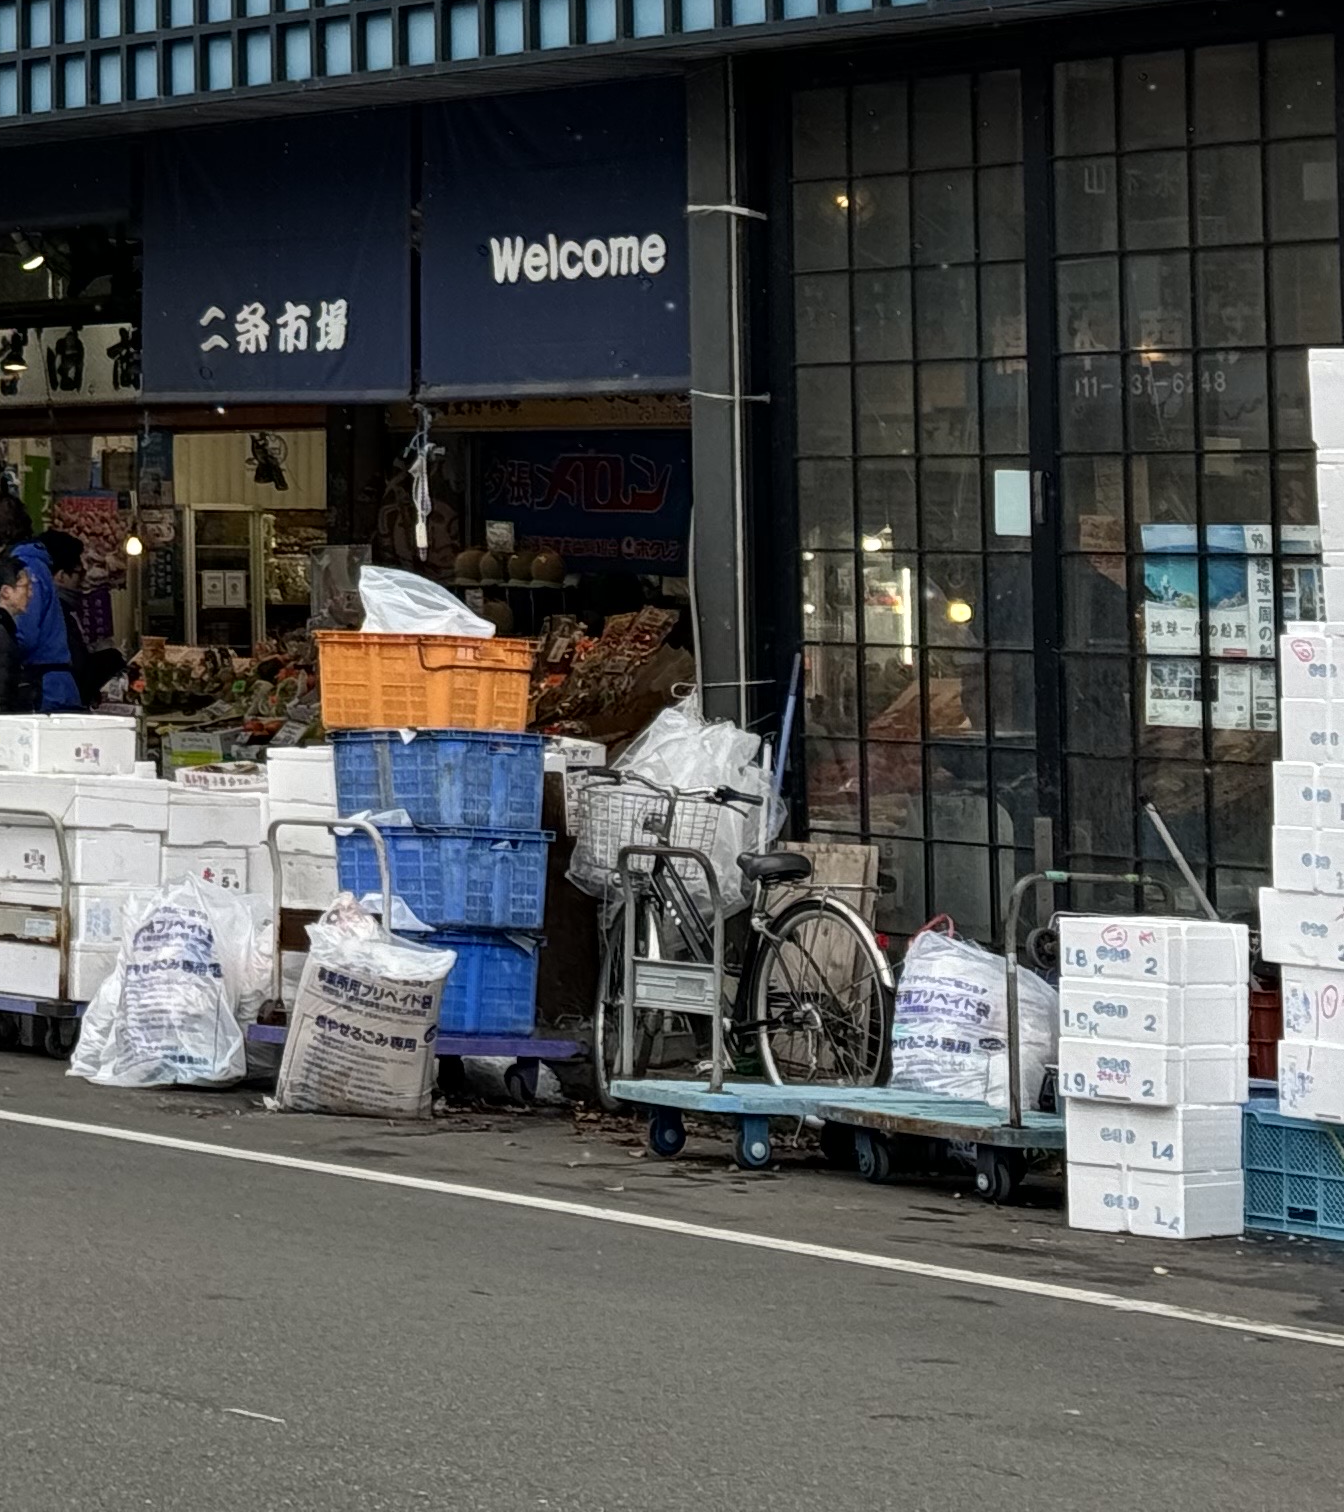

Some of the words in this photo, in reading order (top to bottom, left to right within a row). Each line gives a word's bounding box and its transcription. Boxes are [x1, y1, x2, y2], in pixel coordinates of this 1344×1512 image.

[489, 233, 668, 285] Welcome
[199, 298, 349, 354] 二条市場
[1075, 371, 1227, 398] 11-31-648
[1143, 956, 1158, 976] 2
[1143, 1013, 1157, 1032] 2
[1141, 1079, 1156, 1097] 2
